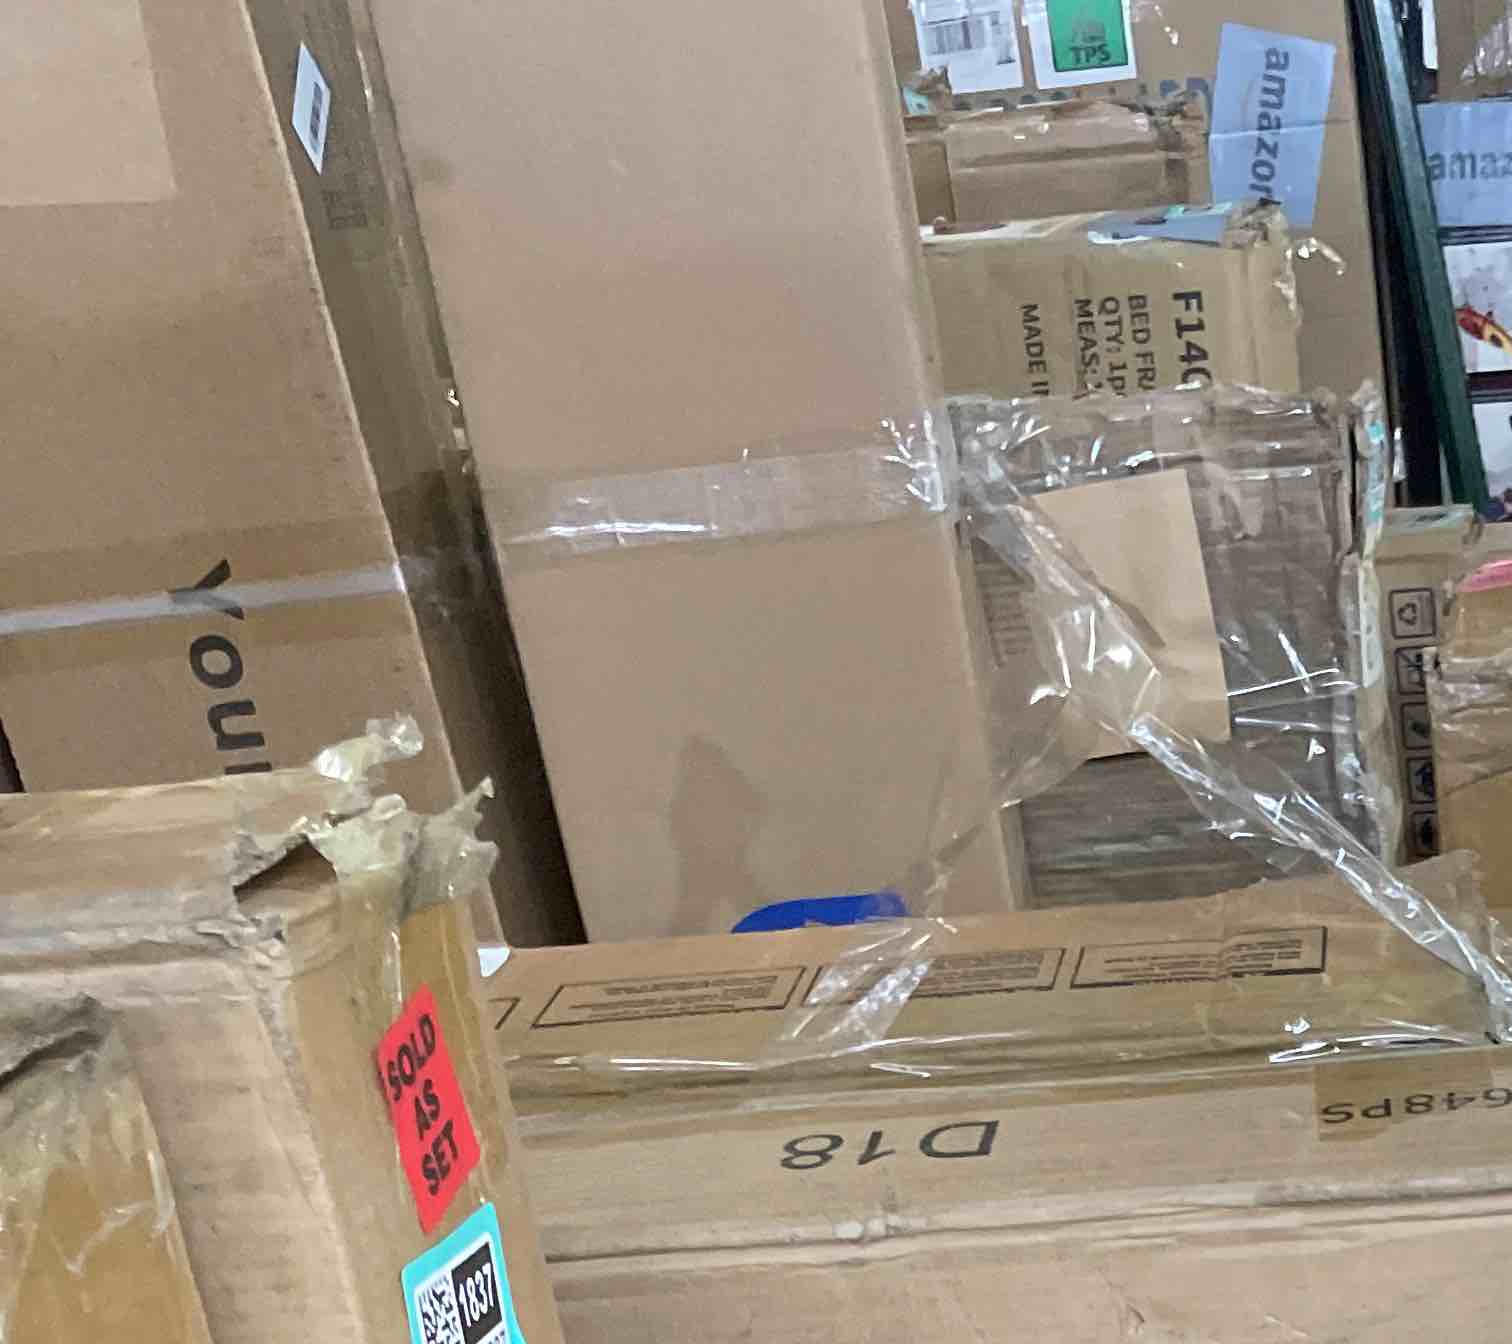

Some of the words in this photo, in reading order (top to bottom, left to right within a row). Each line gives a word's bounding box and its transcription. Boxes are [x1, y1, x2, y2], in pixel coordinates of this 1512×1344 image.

[1021, 304, 1047, 374] MADE
[1128, 295, 1151, 344] BED
[383, 1011, 436, 1100] SOLD
[412, 1084, 441, 1139] AS
[421, 1133, 461, 1195] SET
[780, 1119, 999, 1170] D18
[457, 1263, 496, 1334] 1837
